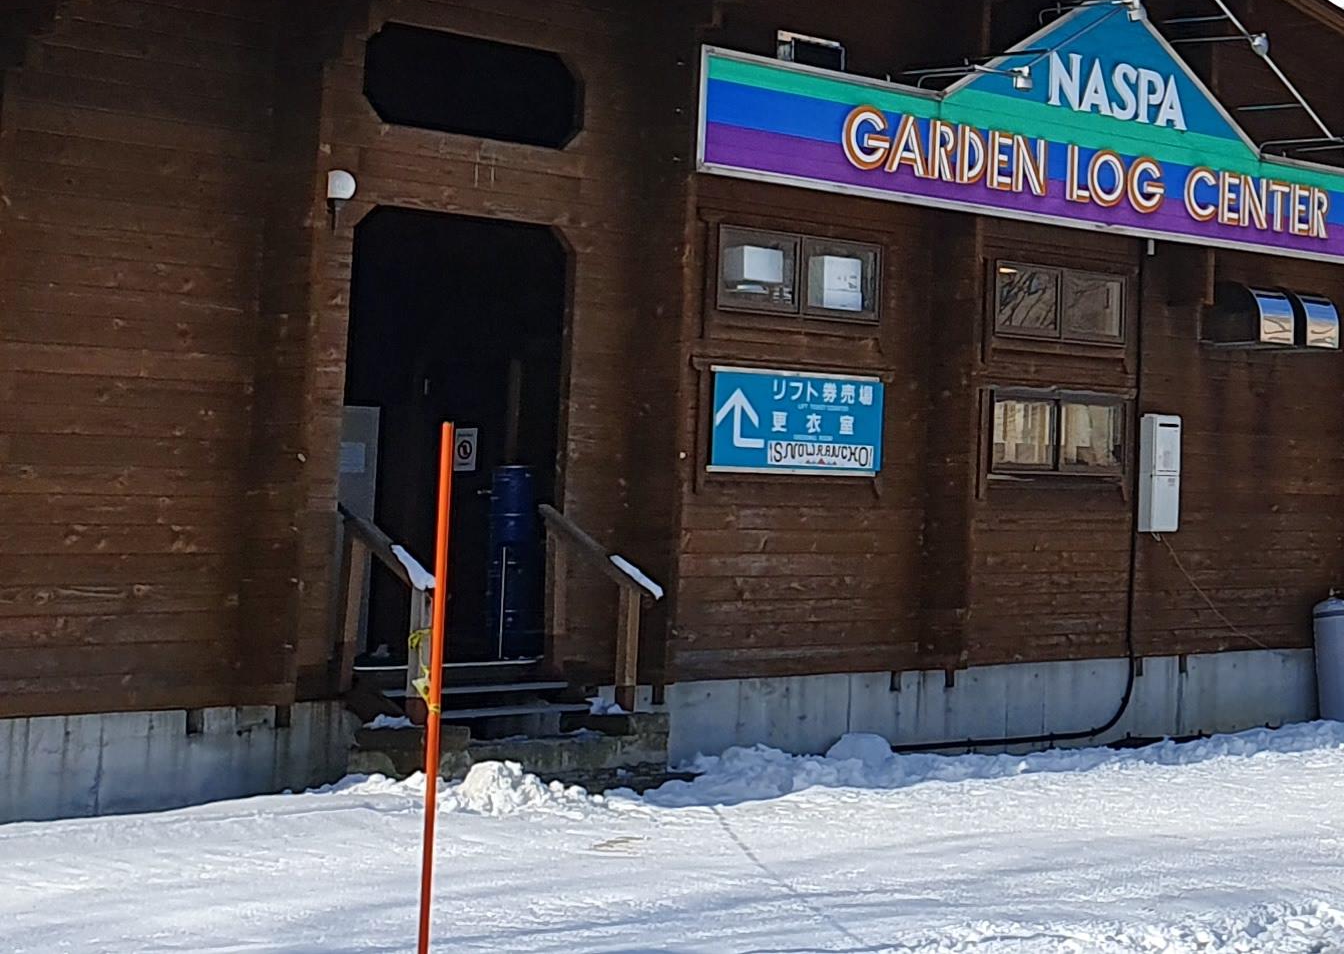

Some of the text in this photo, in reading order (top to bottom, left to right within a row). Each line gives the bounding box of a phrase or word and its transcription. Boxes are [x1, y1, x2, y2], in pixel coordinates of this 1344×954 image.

[1048, 50, 1187, 130] NASPA
[841, 104, 1329, 239] GARDEN LOG CENTER
[772, 378, 874, 406] リフト券売場
